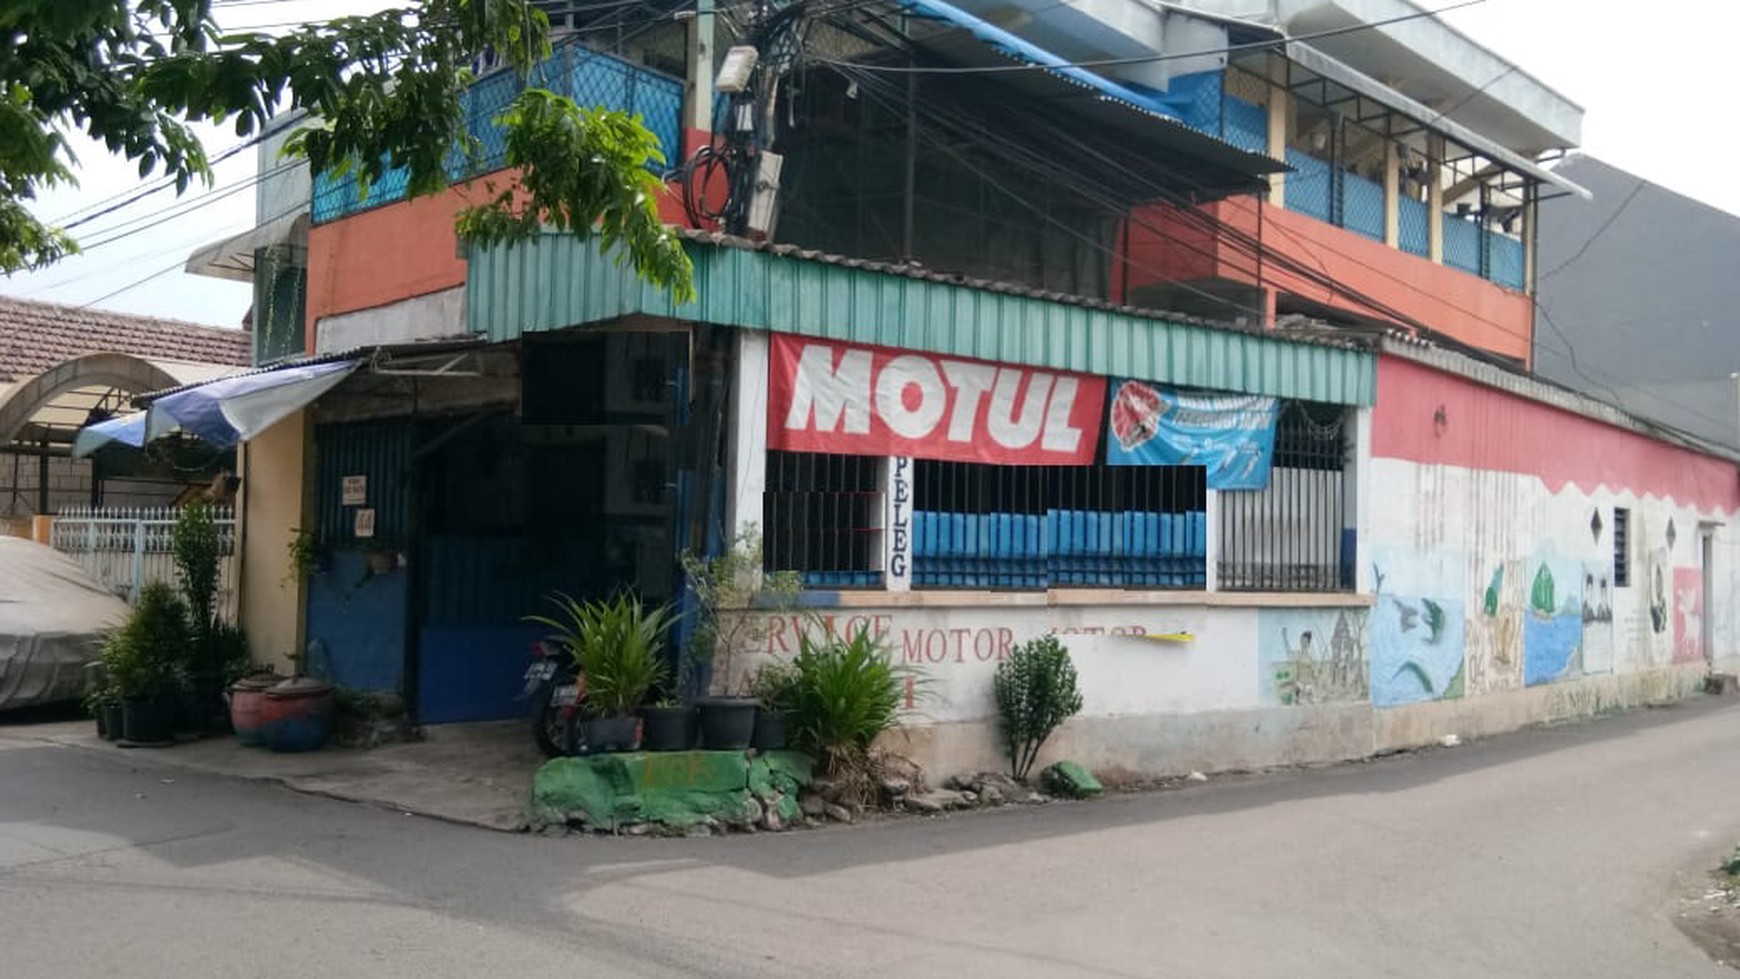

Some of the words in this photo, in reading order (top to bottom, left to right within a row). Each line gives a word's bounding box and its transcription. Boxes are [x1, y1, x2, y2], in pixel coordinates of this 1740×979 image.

[785, 344, 1083, 453] MOTUL
[890, 456, 909, 577] PELEG
[902, 627, 1014, 664] MOTOR
